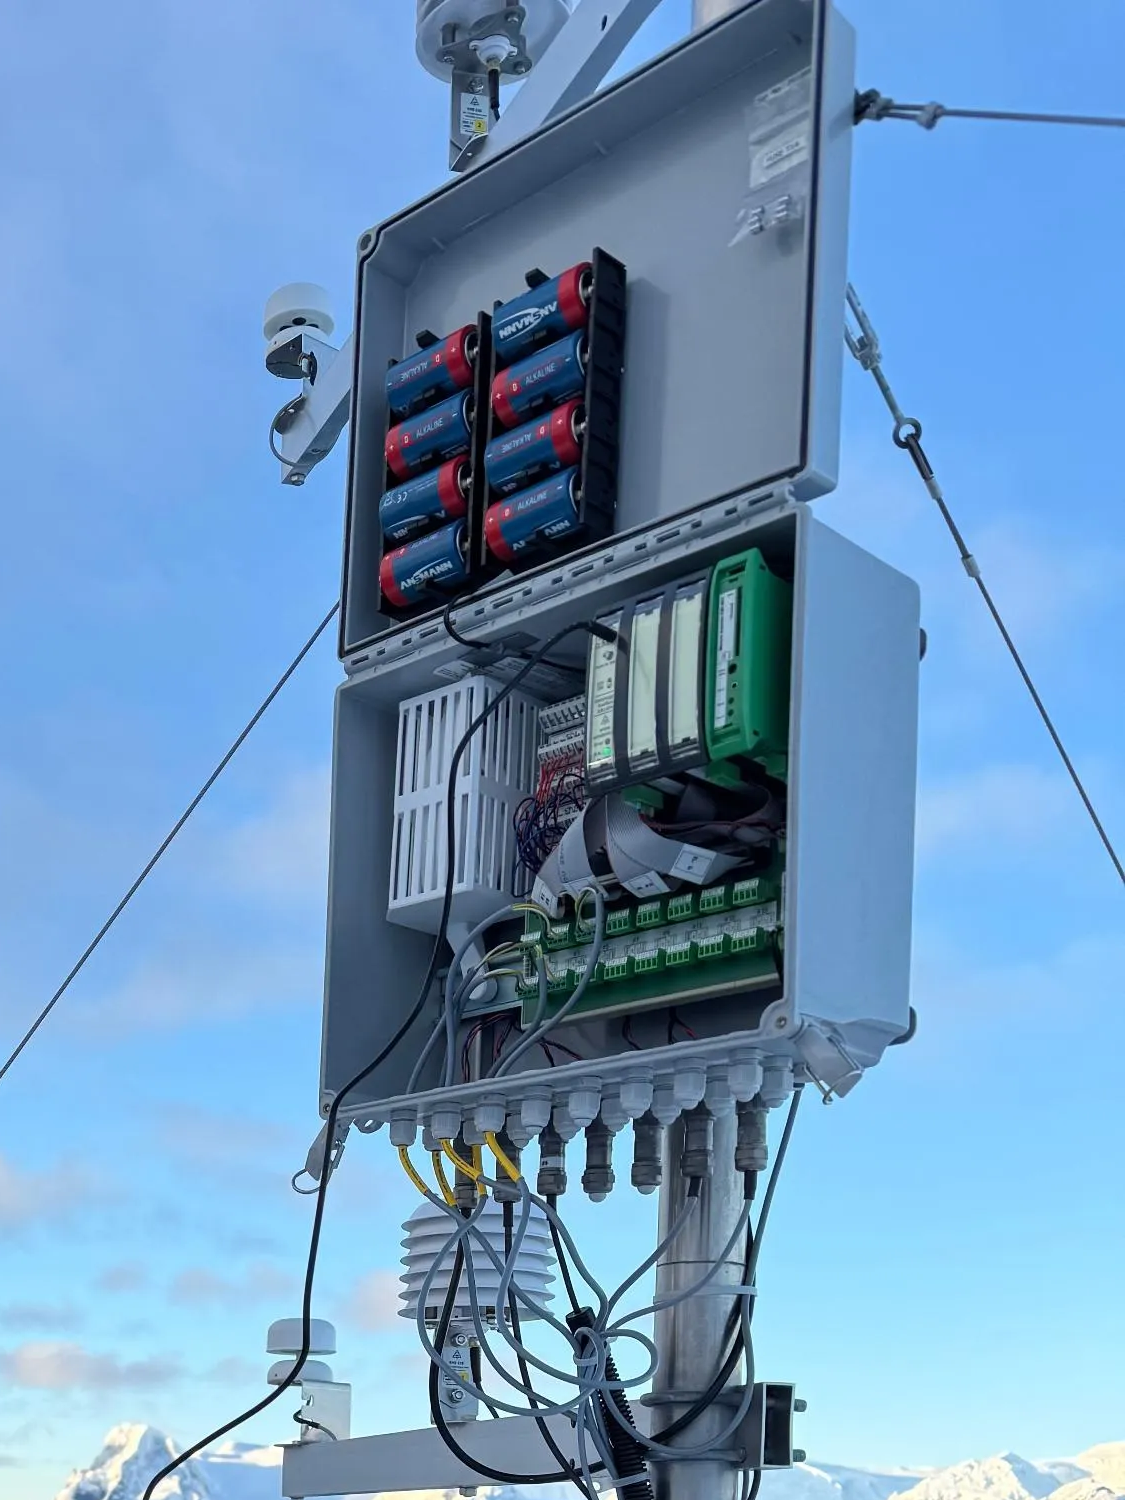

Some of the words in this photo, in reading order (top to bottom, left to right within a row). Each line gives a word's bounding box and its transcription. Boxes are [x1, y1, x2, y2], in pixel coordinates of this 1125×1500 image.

[498, 301, 557, 339] ANSMANN
[525, 362, 556, 384] ALKALINE
[416, 418, 443, 438] ALKALINE
[517, 491, 547, 511] ALKALINE
[400, 560, 453, 590] ANSMANN
